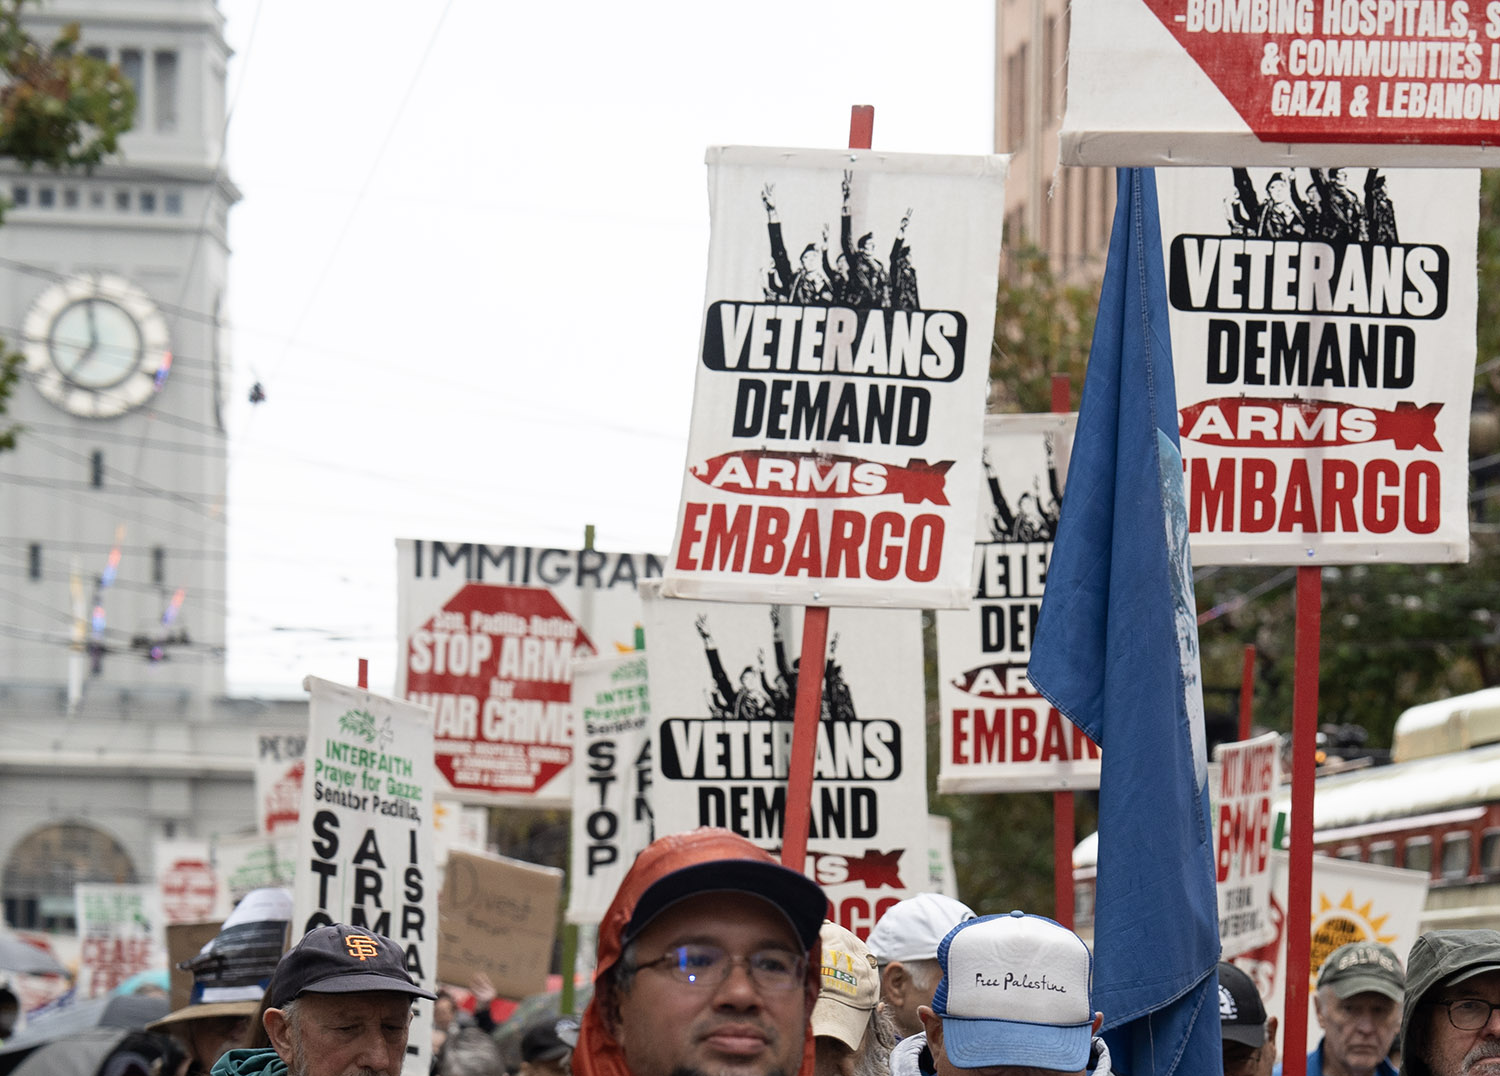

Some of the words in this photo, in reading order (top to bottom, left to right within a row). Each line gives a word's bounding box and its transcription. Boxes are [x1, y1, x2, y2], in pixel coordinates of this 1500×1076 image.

[1322, 0, 1477, 42] HOSPITALS,
[1260, 41, 1280, 76] &
[1288, 40, 1483, 80] COMMUNITIES
[1271, 80, 1342, 118] GAZA
[1349, 84, 1369, 119] &
[1182, 237, 1440, 317] VETERANS
[719, 303, 960, 380] VETERANS
[1206, 318, 1416, 389] DEMAND
[731, 379, 932, 447] DEMAND
[1188, 404, 1378, 442] ARMS
[710, 457, 889, 494] ARMS
[1182, 457, 1441, 534] MBARGO
[674, 502, 946, 583] EMBARGO
[410, 630, 493, 677] STOP
[498, 636, 584, 683] ARM
[968, 667, 1043, 696] AR
[481, 698, 575, 746] CRIME
[952, 708, 1100, 764] EMBAR
[314, 758, 357, 790] Prayer
[361, 769, 381, 792] for
[326, 738, 413, 778] INTERFAITH
[669, 719, 897, 779] VETERANS
[314, 780, 369, 812] Senator
[373, 795, 422, 827] Padilla,
[586, 741, 619, 877] STOP
[699, 786, 878, 839] DEMND
[305, 810, 340, 938] ST
[351, 829, 391, 938] ARM
[975, 972, 1000, 988] Free
[1003, 972, 1067, 994] Palestine
